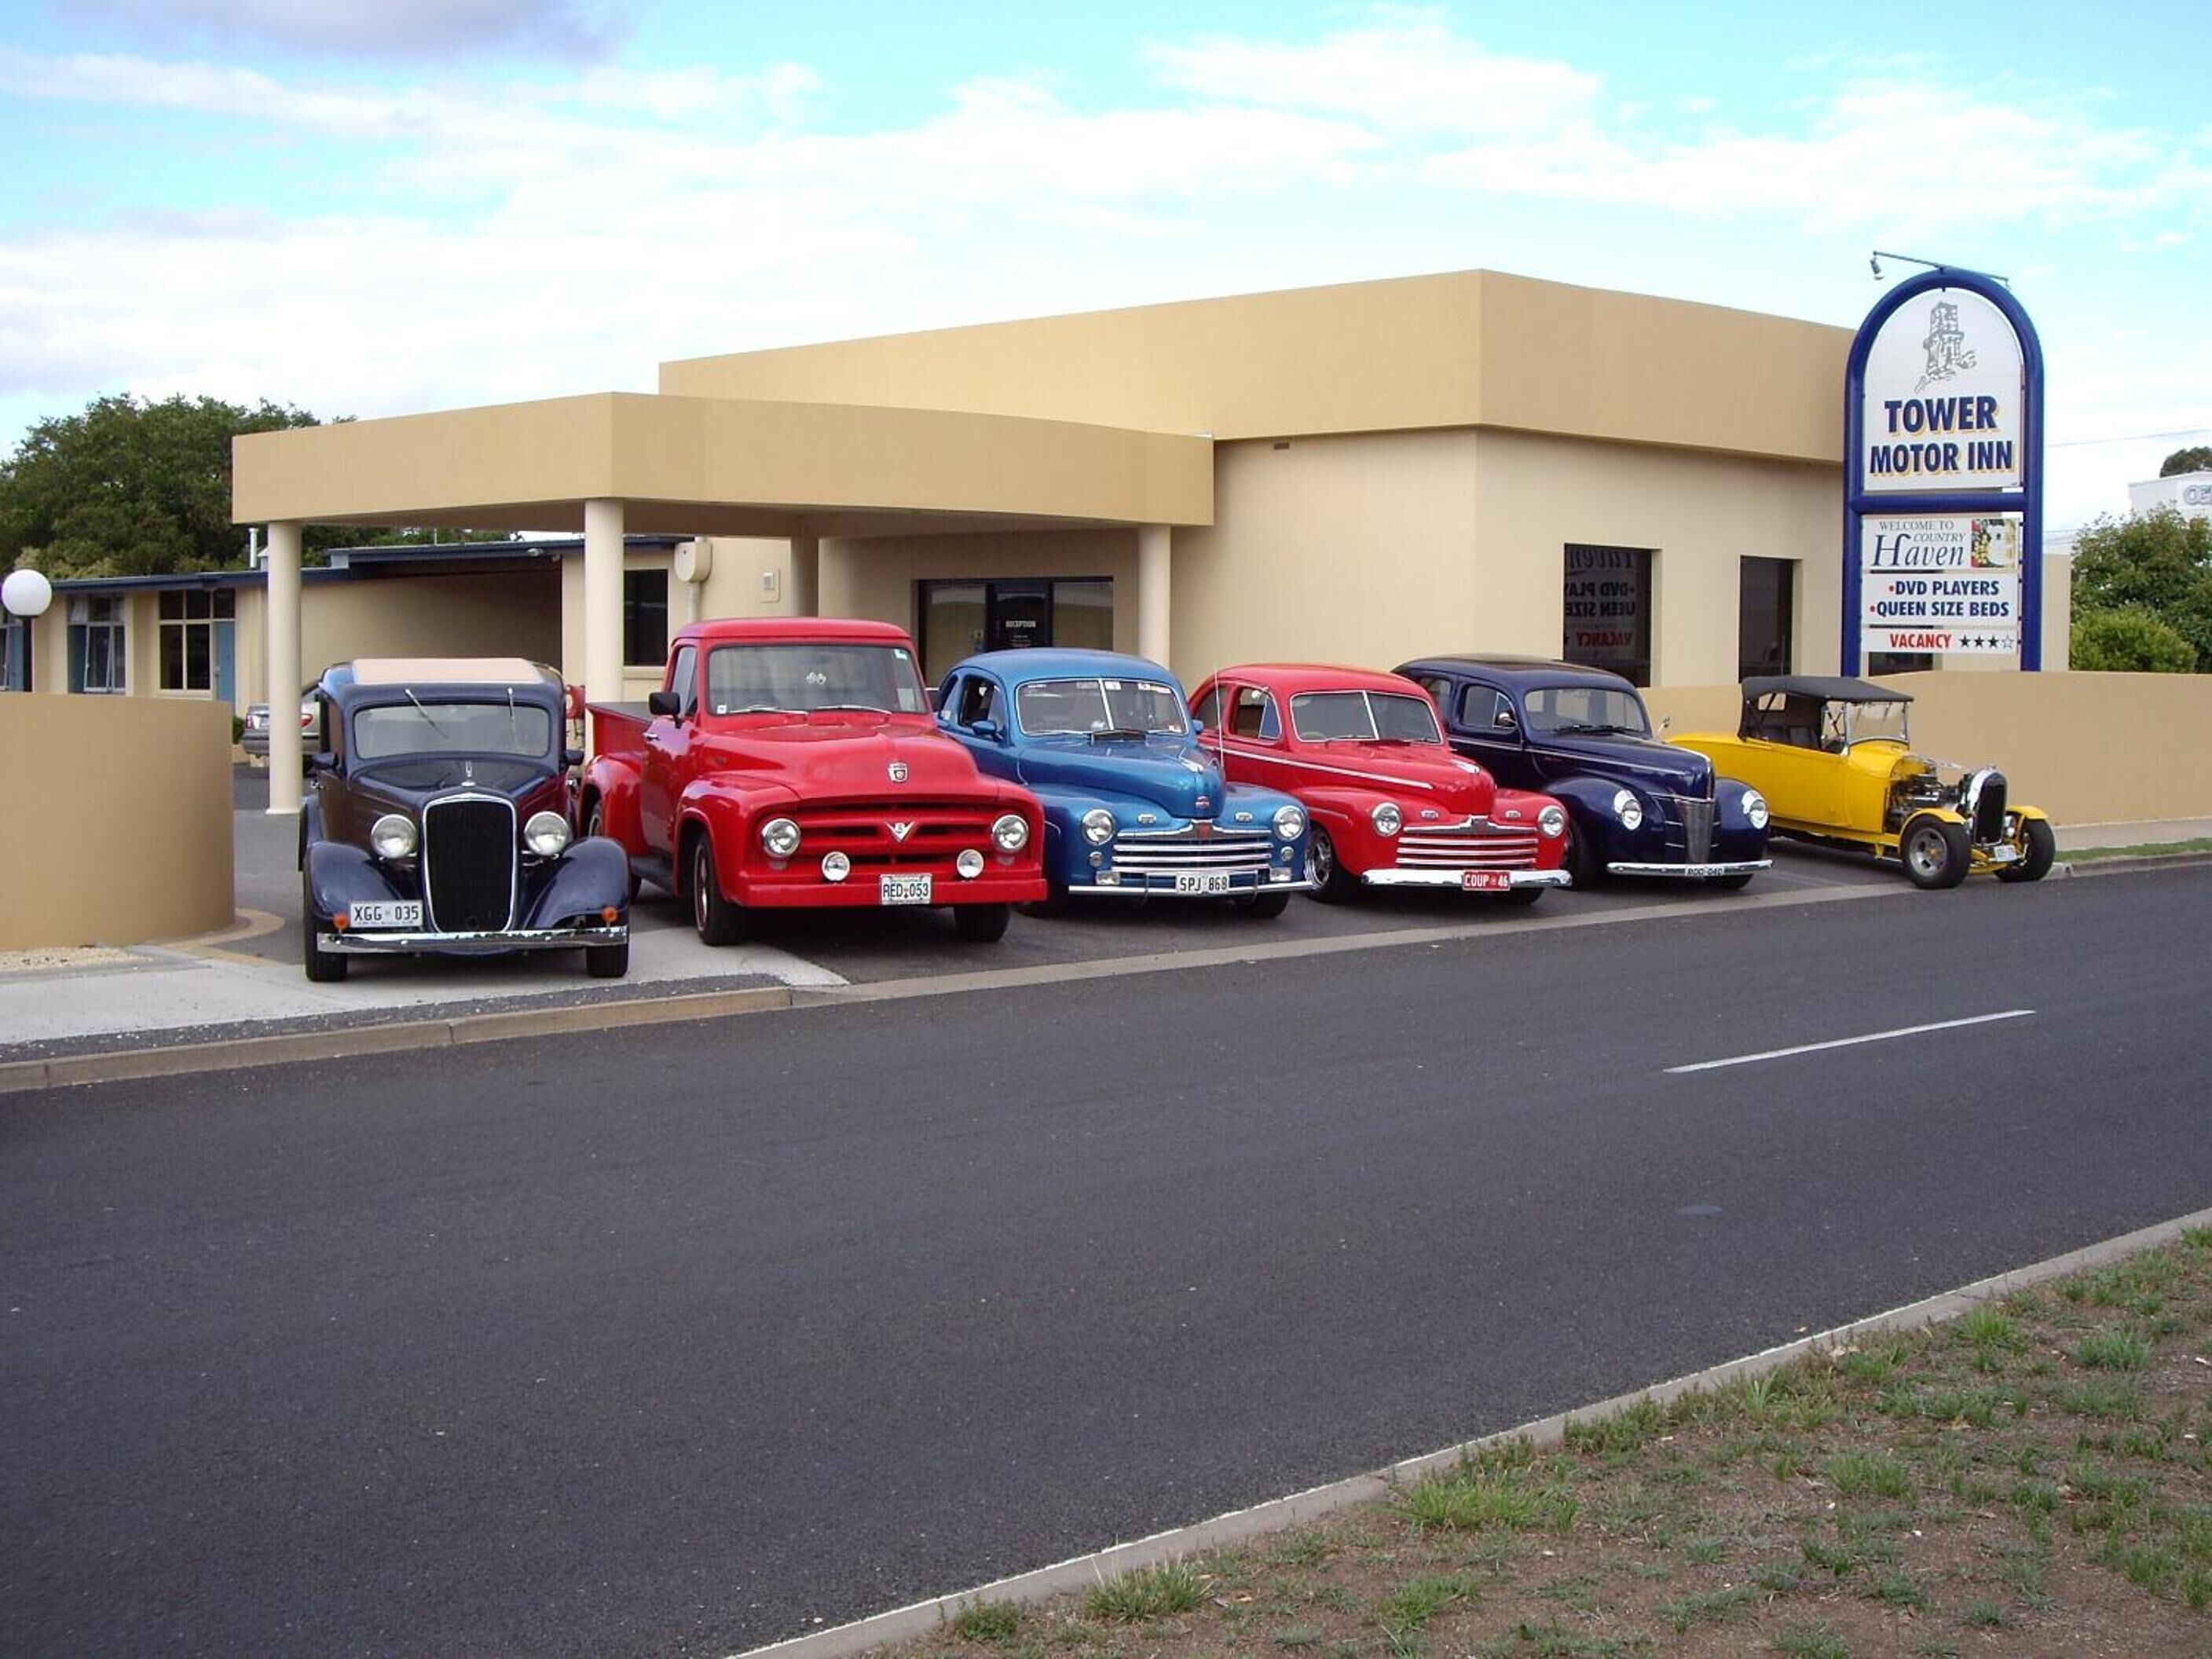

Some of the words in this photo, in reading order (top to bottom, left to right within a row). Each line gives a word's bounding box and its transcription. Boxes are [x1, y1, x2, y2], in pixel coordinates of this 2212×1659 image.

[1884, 395, 1999, 434] TOWER
[1870, 442, 1959, 474] MOTOR
[1968, 441, 2012, 471] INN
[1879, 521, 1935, 531] WELCOME
[1939, 521, 1954, 530] TO
[1914, 533, 1966, 542] COUNTRY
[1872, 533, 1965, 566] Haven
[1895, 581, 1928, 595] DVD
[1932, 580, 2000, 595] PLAYERS
[1877, 602, 1926, 617] QUEEN
[1932, 602, 1963, 616] SIZE
[1969, 602, 2009, 617] BEDS
[1890, 634, 1952, 648] VACANCY
[1180, 877, 1201, 892] SPJ
[1465, 874, 1489, 887] COUP
[883, 883, 903, 897] RED
[910, 882, 928, 897] 053
[354, 906, 383, 921] XGG
[394, 905, 419, 921] 035
